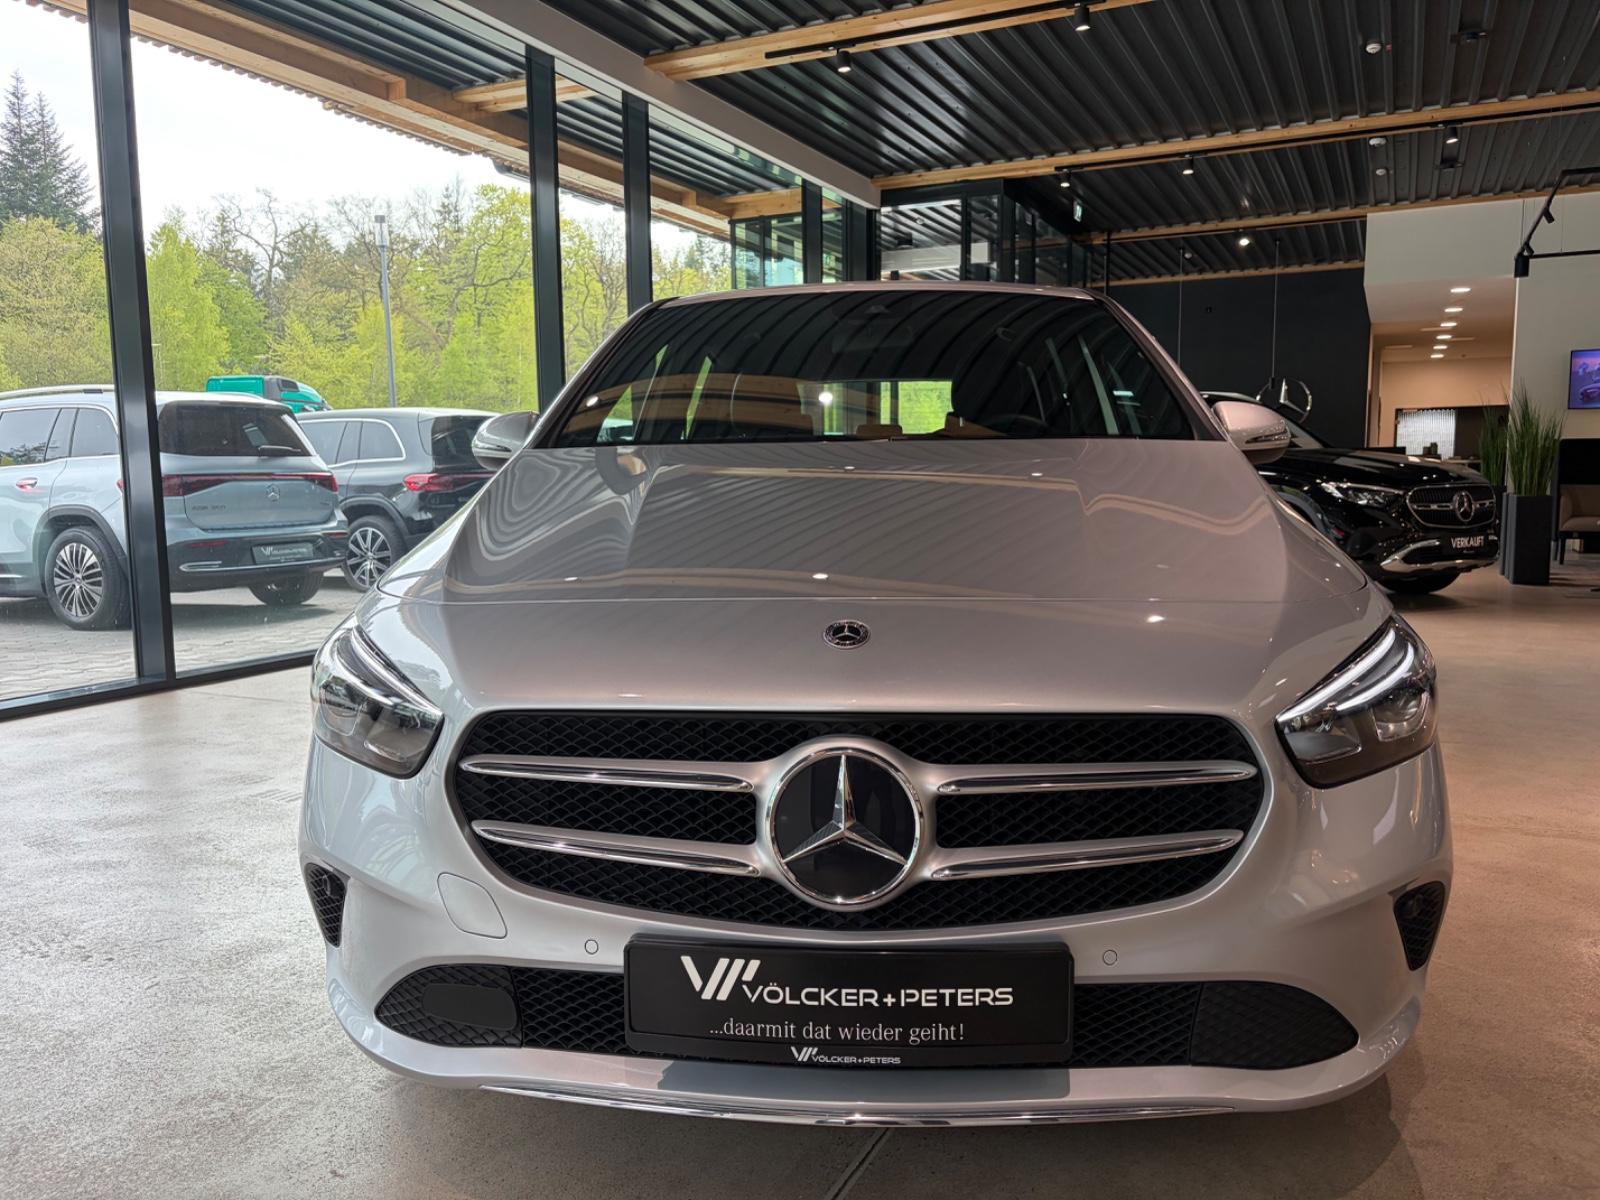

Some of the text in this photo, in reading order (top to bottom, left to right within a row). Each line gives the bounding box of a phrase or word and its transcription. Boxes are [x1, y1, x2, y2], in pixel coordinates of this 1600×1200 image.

[1450, 535, 1485, 549] VERKAUFT
[742, 982, 1014, 1008] VÖLCKER+PETERS
[802, 1021, 832, 1041] dat
[838, 1023, 903, 1041] wieder
[908, 1023, 964, 1046] geiht!
